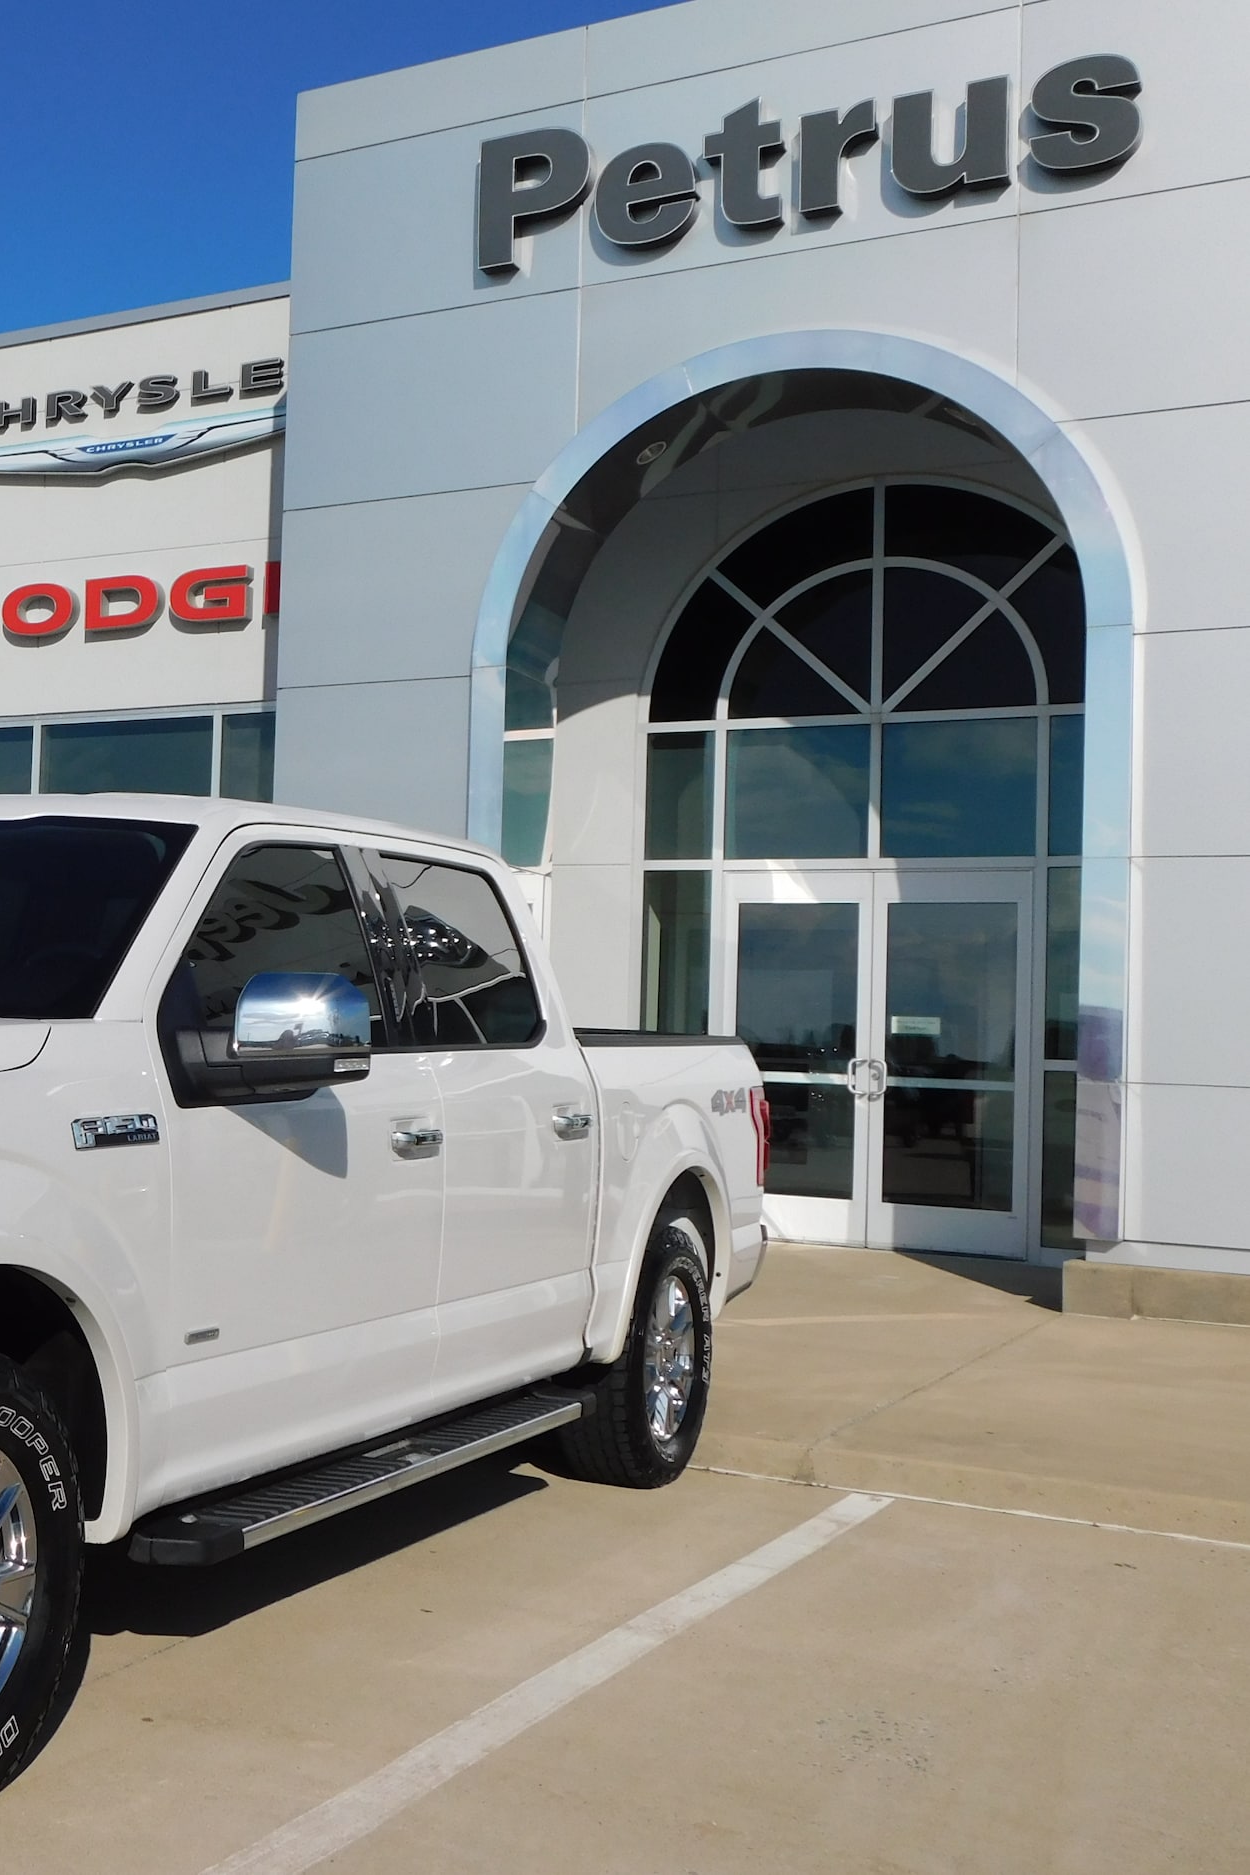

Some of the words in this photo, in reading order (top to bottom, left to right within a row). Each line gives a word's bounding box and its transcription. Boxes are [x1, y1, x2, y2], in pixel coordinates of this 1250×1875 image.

[477, 53, 1142, 274] Petrus
[86, 438, 163, 453] CHRYSLER
[127, 1132, 157, 1142] LARIAT
